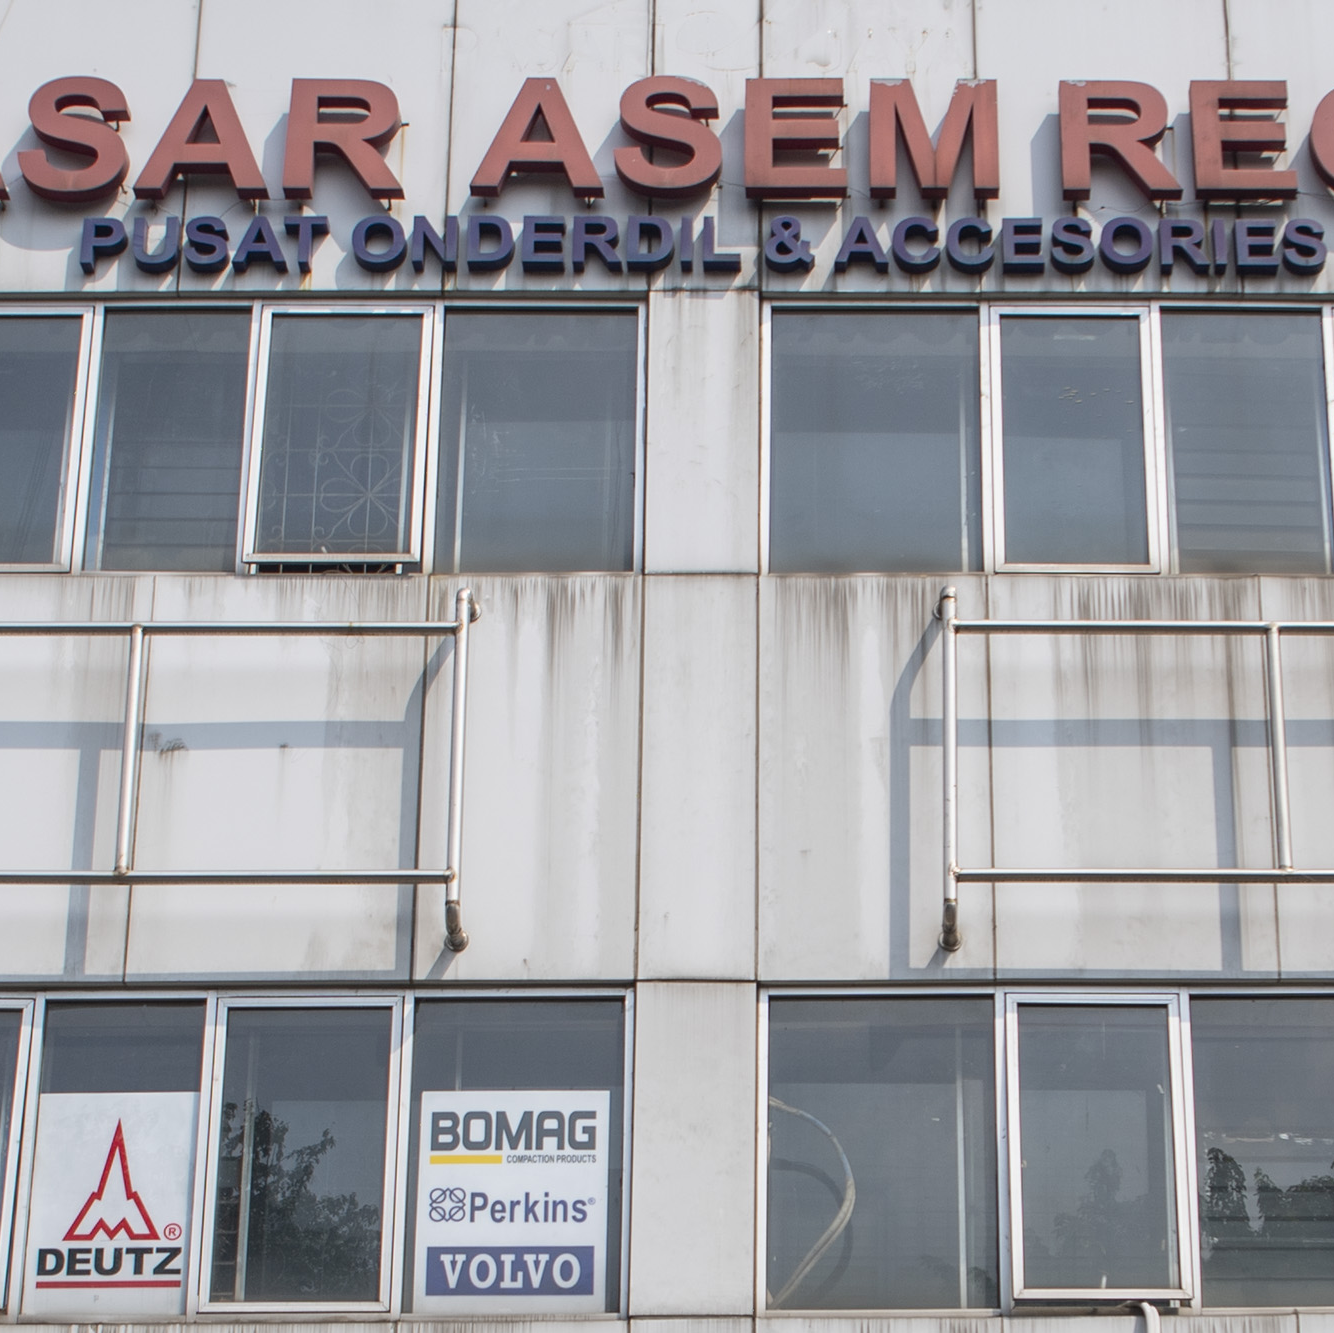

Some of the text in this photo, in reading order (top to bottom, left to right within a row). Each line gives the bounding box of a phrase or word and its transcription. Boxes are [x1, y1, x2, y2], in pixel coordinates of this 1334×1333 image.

[469, 76, 1000, 201] ASEM
[78, 214, 1329, 276] PUSAT ONDERDIL & ACCESORIES
[430, 1111, 597, 1151] BOMAG
[507, 1154, 597, 1164] COMPACTION PRODUCTS
[36, 1247, 182, 1276] DEUTZ
[440, 1253, 581, 1289] VOLVO
